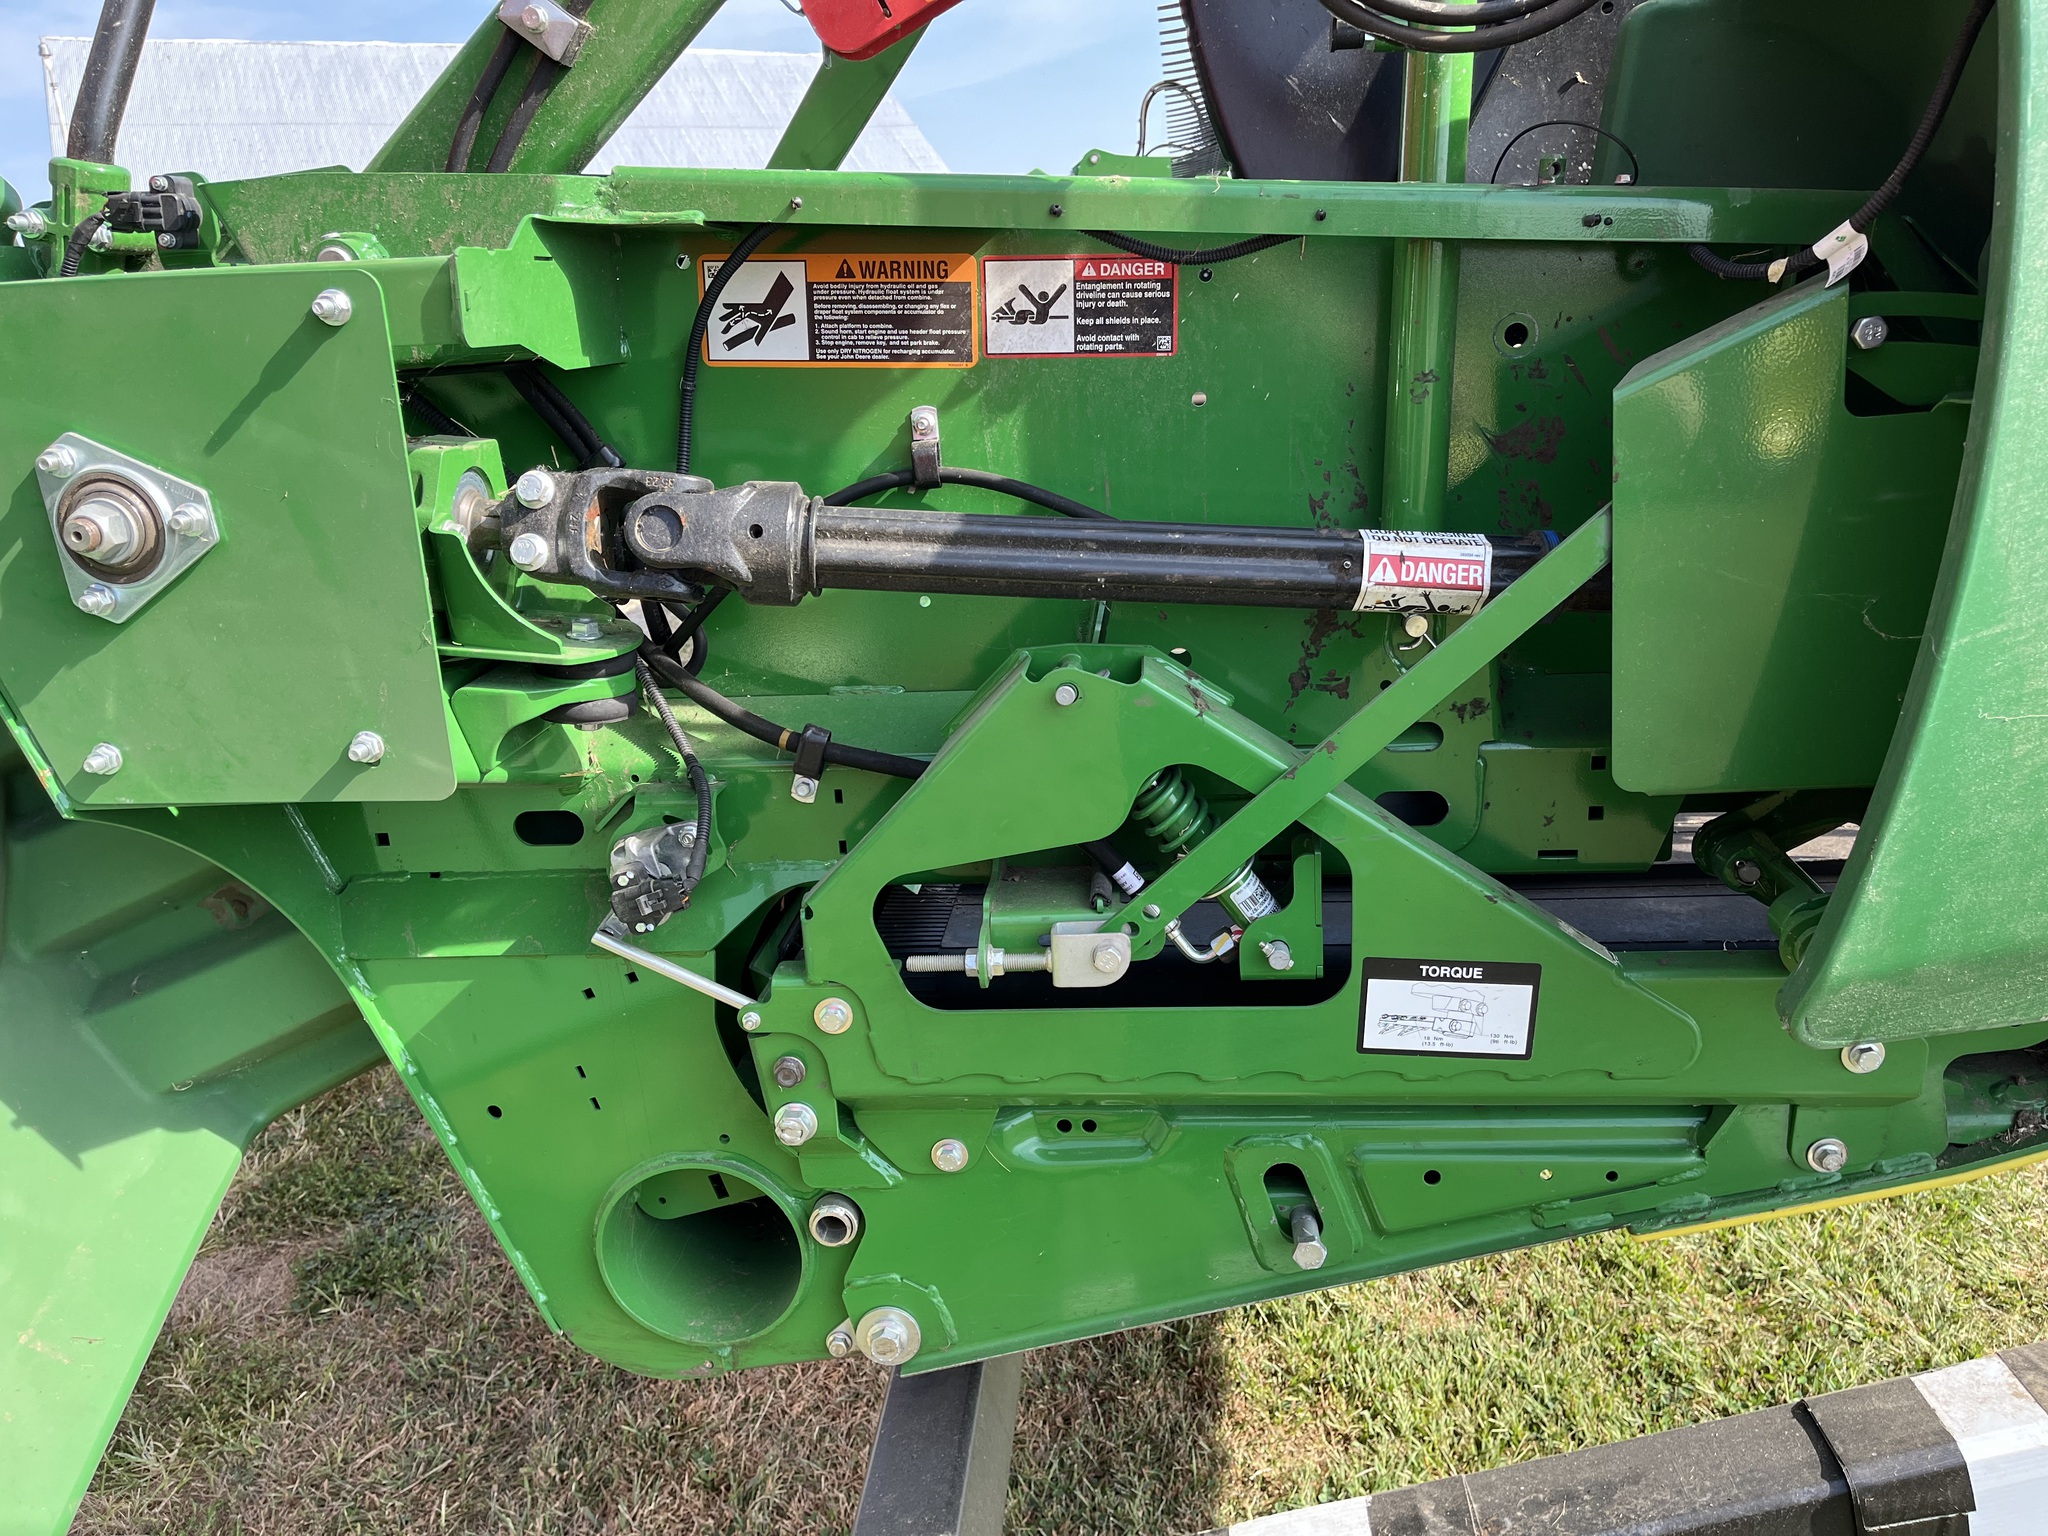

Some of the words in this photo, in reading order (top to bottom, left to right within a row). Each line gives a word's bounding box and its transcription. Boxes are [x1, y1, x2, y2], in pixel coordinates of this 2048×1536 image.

[858, 260, 948, 279] WARNING
[1100, 262, 1164, 276] DANGER
[1076, 282, 1124, 291] Entanglement
[1134, 281, 1161, 290] rotating
[1076, 291, 1106, 299] driveline
[1076, 300, 1096, 309] injury
[1077, 317, 1094, 326] Keep
[1096, 317, 1104, 325] all
[1141, 317, 1162, 325] place.
[1077, 334, 1096, 342] Avoid
[1098, 334, 1123, 342] contact
[1077, 343, 1103, 353] rotating
[1105, 343, 1125, 352] parts.
[1424, 538, 1484, 547] OPERATE
[1400, 561, 1483, 586] DANGER
[1420, 965, 1483, 979] TORQUE
